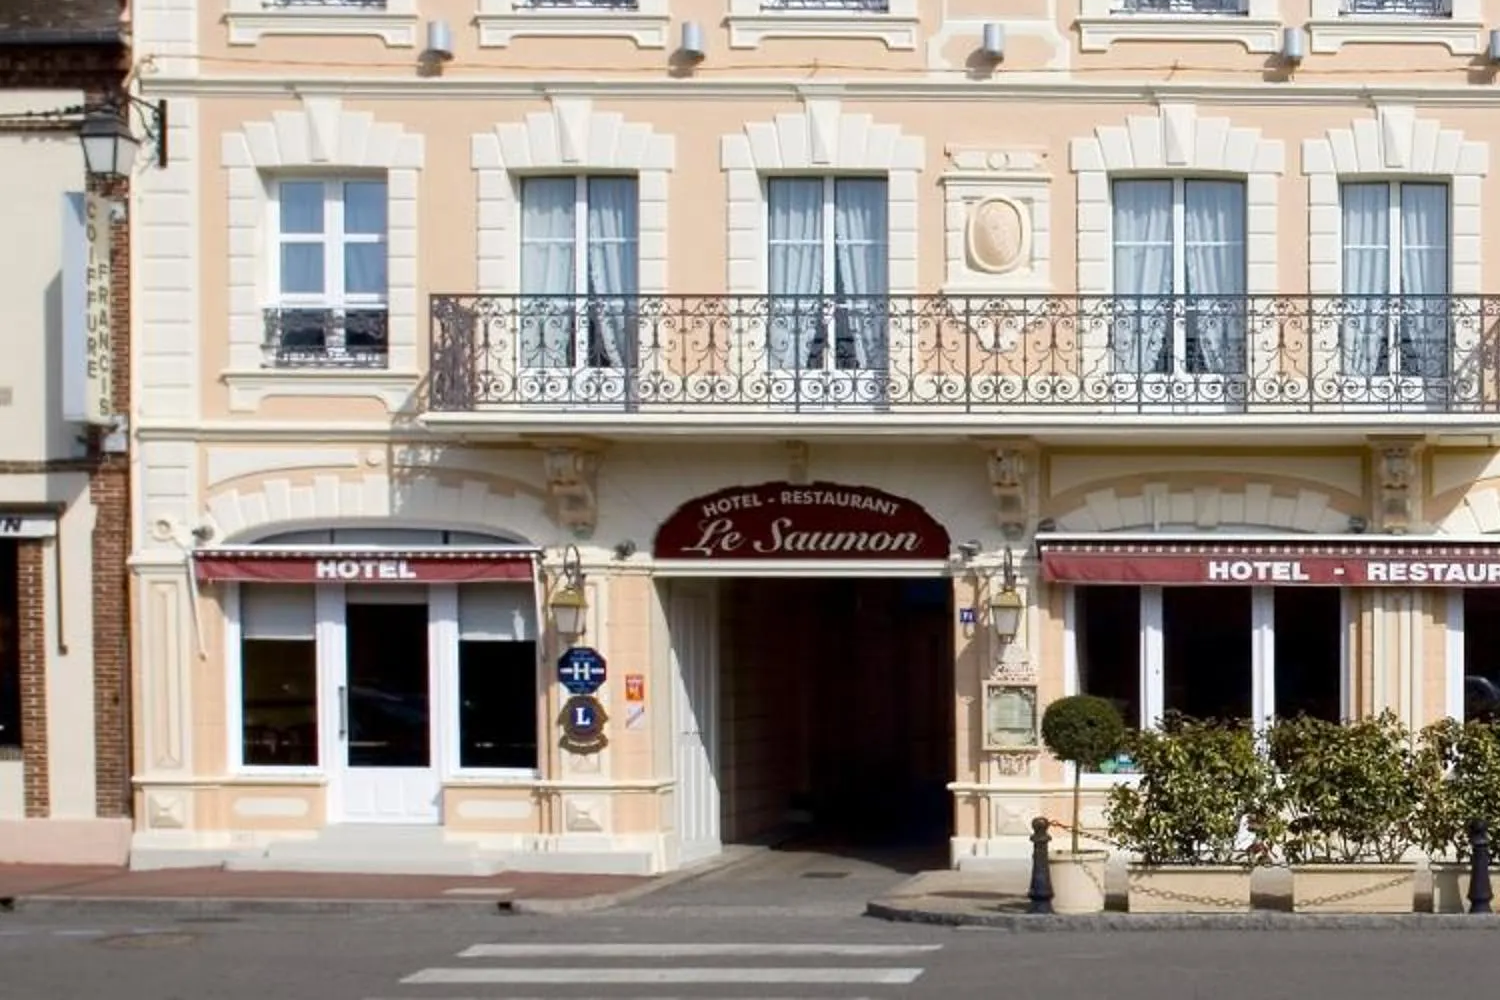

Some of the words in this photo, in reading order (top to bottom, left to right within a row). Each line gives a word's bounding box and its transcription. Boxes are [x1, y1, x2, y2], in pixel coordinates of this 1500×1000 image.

[86, 203, 97, 379] COIFFURE
[98, 264, 109, 415] FRANCIS
[703, 493, 762, 518] HOTEL
[781, 490, 900, 516] RESTAURANT
[680, 518, 746, 556] Le
[753, 516, 924, 553] Saumon
[316, 560, 417, 579] HOTEL
[1208, 561, 1309, 581] HOTEL
[575, 707, 591, 725] L
